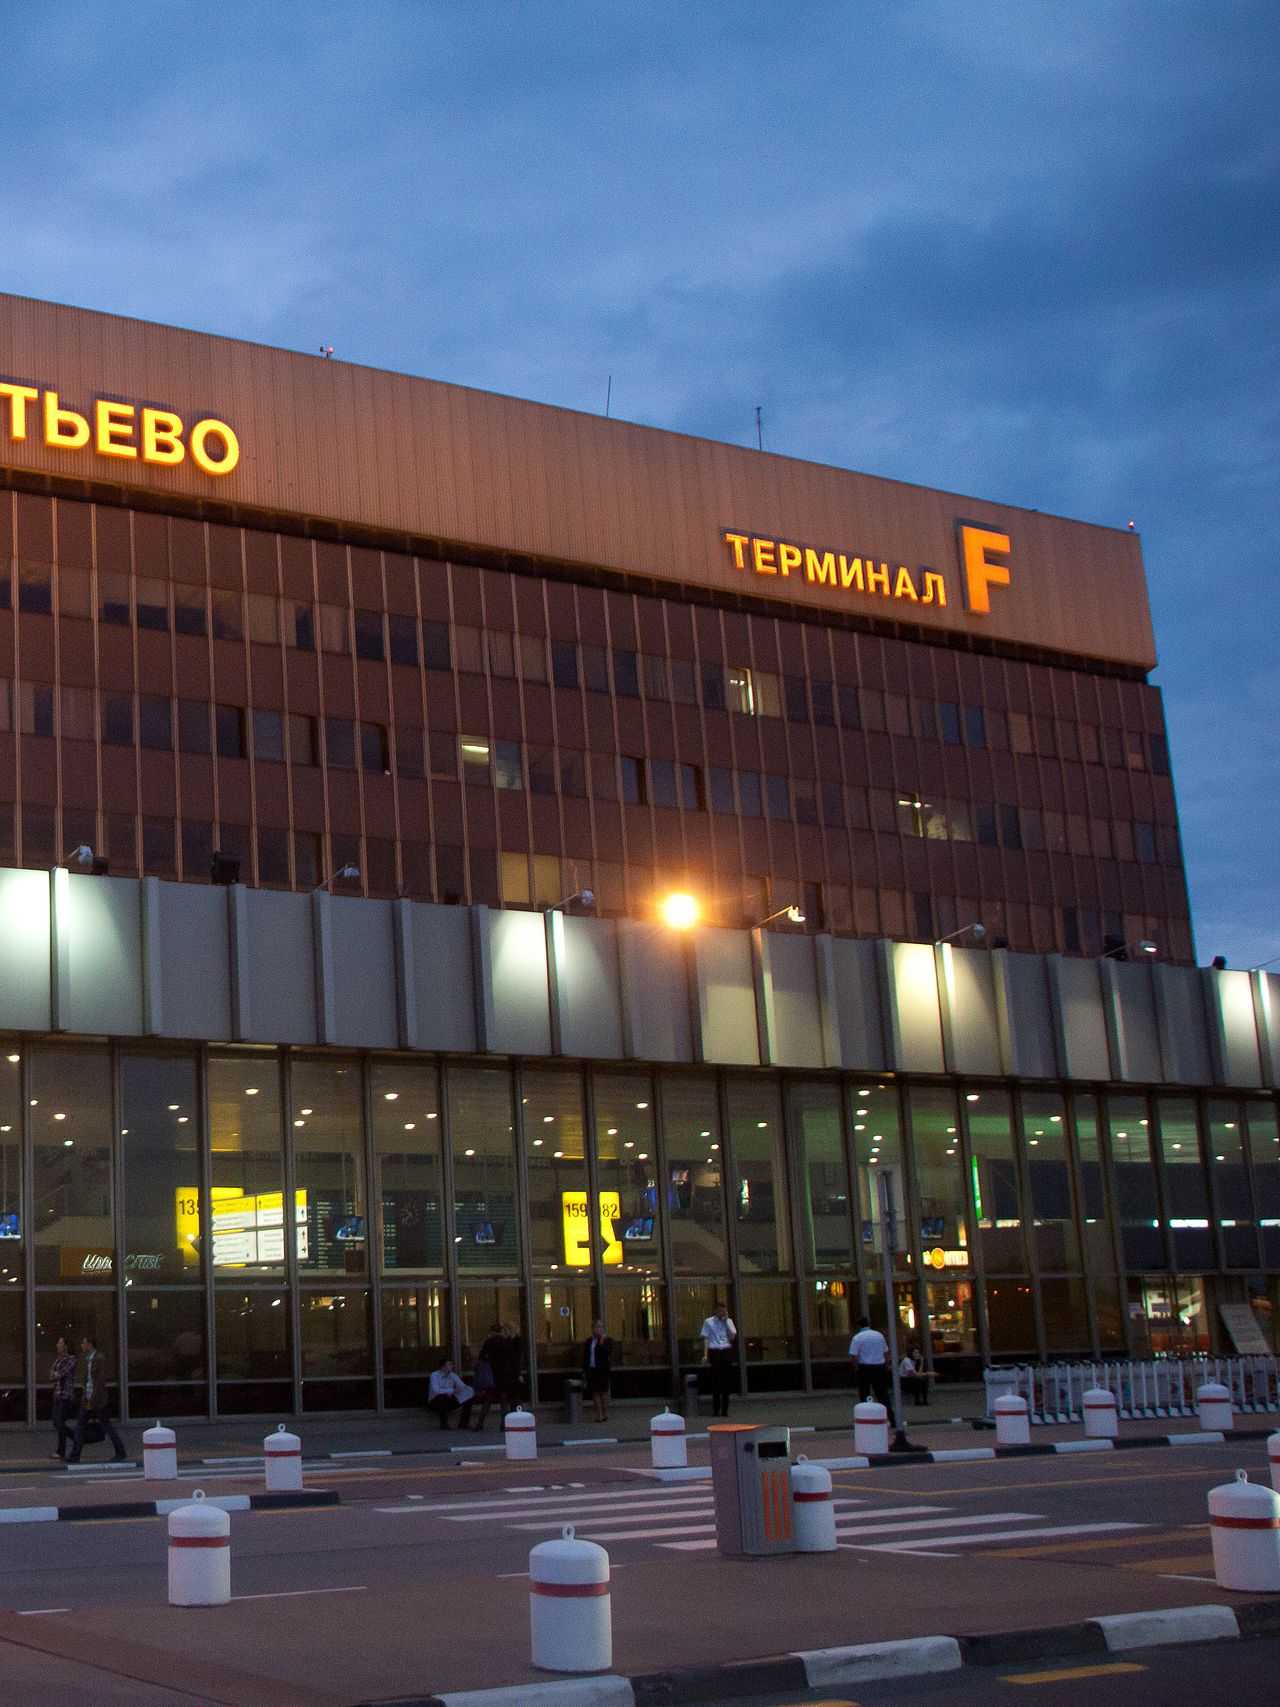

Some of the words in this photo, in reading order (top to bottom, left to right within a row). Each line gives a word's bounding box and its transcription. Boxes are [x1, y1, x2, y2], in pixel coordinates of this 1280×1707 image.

[724, 532, 948, 608] ТЕРМИНАЛ
[962, 525, 1011, 615] F
[179, 1200, 199, 1216] 13
[565, 1203, 588, 1218] 159
[602, 1203, 618, 1218] 82
